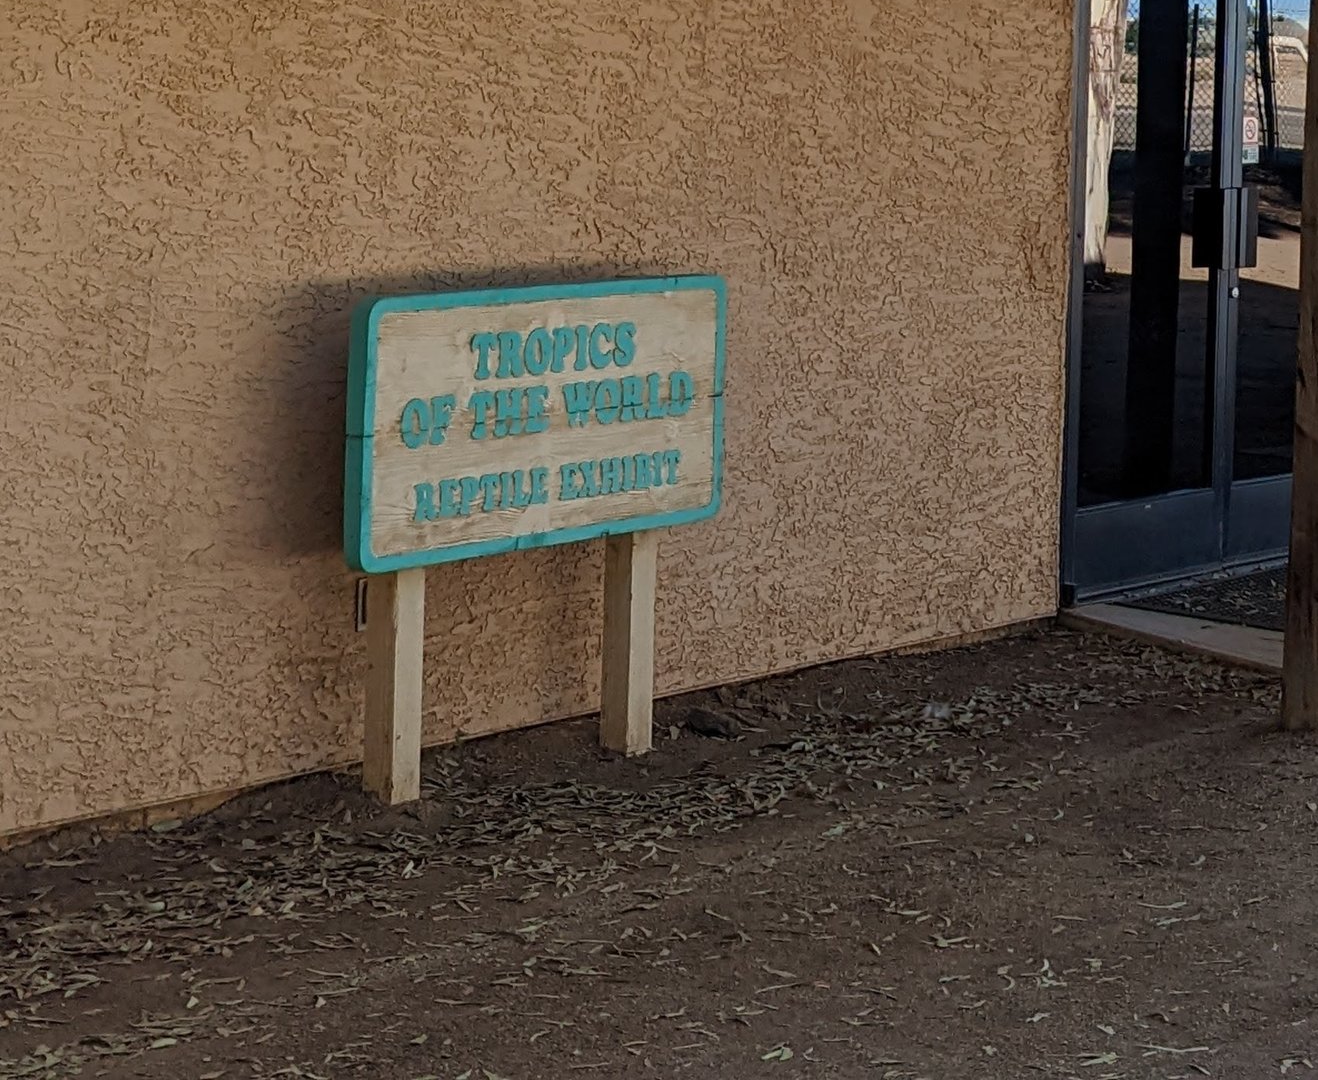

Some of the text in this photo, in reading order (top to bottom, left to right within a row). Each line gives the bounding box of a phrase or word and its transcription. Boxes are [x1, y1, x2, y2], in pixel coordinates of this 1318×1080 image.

[471, 322, 638, 380] TROPICS
[401, 371, 695, 449] OF THE WORLD
[413, 449, 682, 522] REPTILE EXHIBIT
